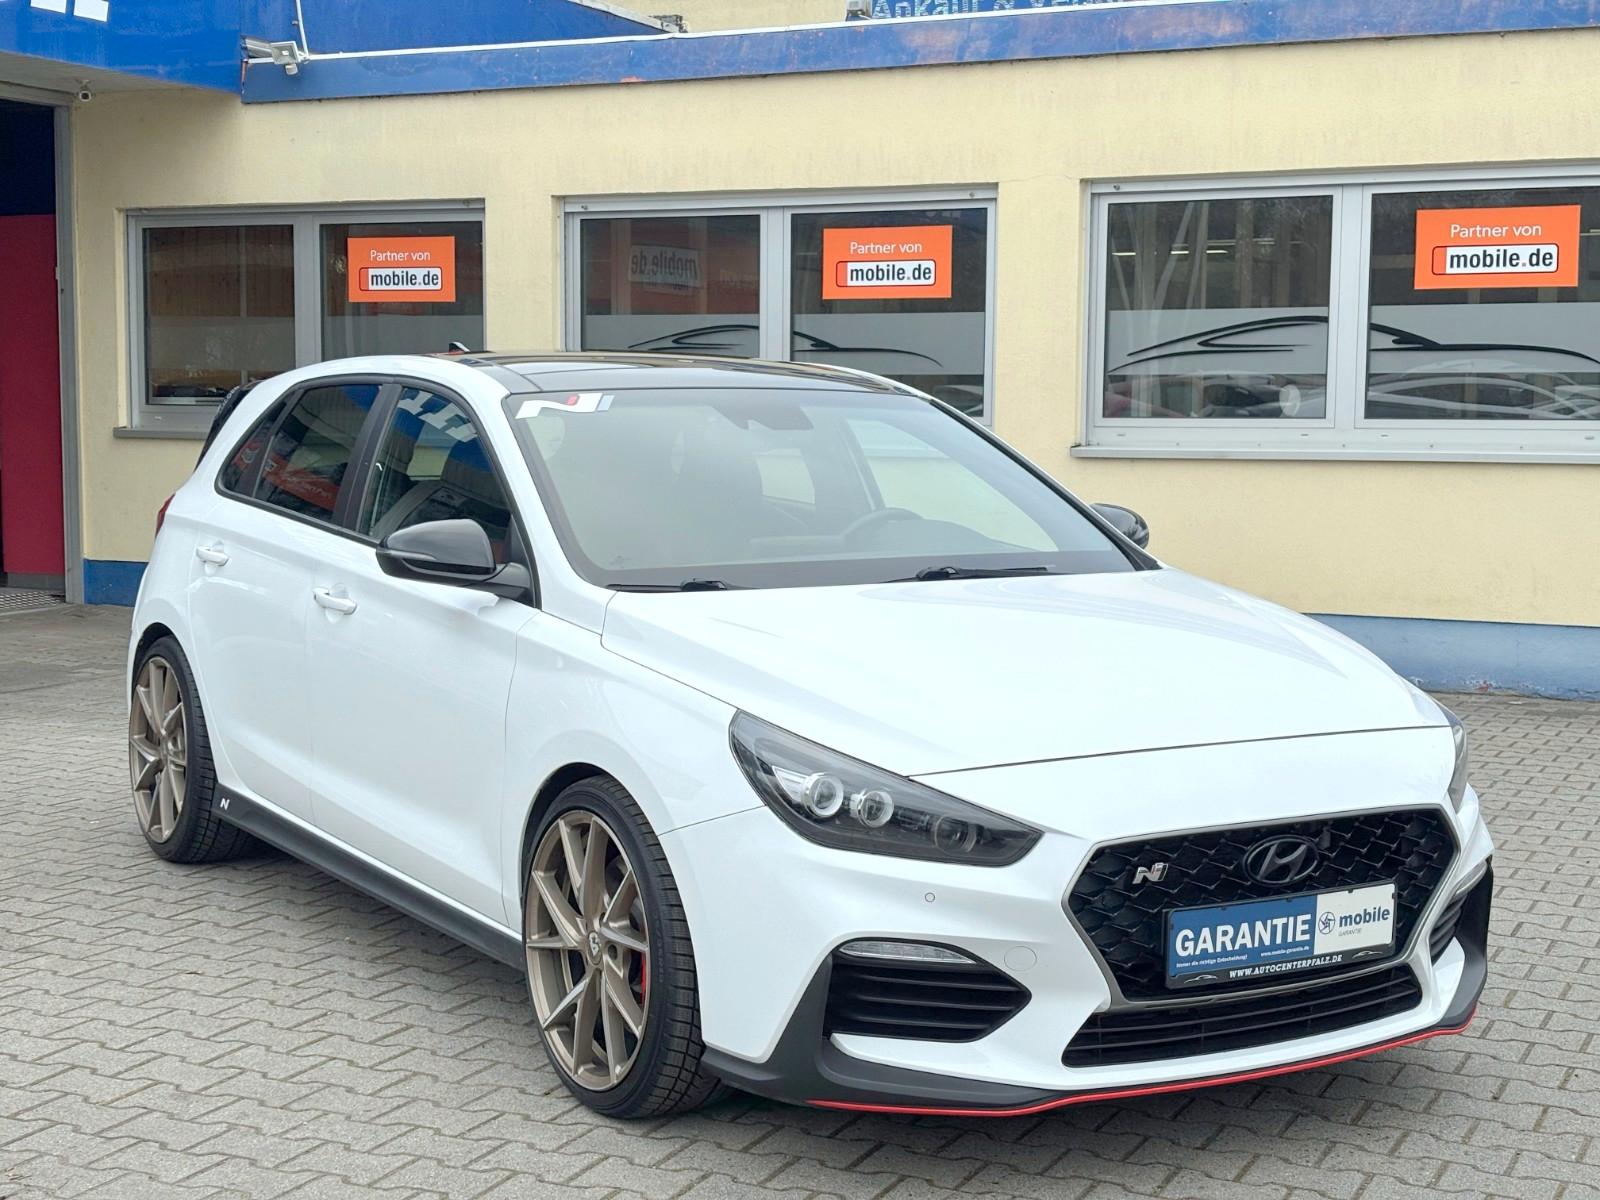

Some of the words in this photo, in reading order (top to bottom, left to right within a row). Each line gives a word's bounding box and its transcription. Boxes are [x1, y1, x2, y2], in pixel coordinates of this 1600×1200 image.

[1450, 224, 1508, 238] Partner
[1513, 225, 1542, 236] von
[370, 249, 408, 261] Partner
[411, 252, 431, 261] von
[850, 241, 895, 254] Partner
[899, 243, 922, 253] von
[1449, 248, 1554, 269] mobile.de
[371, 270, 439, 286] mobile.de
[850, 264, 932, 282] mobile.de
[220, 798, 230, 810] N
[1338, 906, 1391, 928] mobile
[1175, 914, 1312, 957] GARANTIE
[1229, 955, 1343, 979] WWW.AUTOCENTERPFALZ.DE
